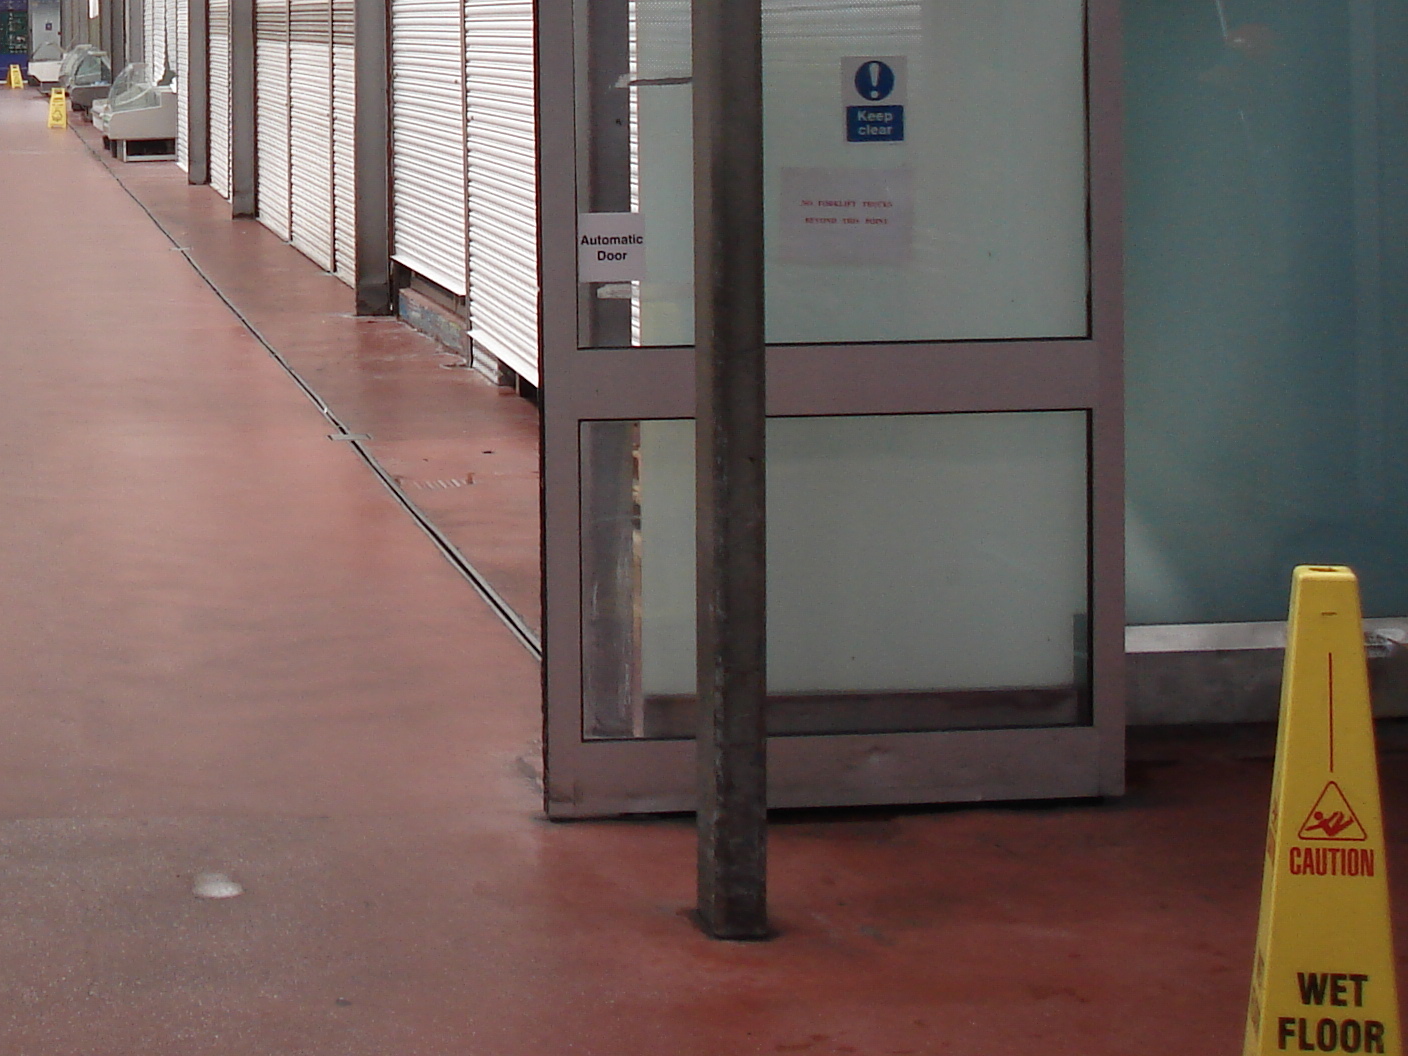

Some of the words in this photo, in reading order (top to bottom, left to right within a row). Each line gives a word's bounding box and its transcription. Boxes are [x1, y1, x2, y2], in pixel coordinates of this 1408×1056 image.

[857, 110, 893, 123] Keep
[858, 123, 892, 135] clear
[580, 234, 644, 245] Automatic
[597, 250, 628, 261] Door
[1289, 846, 1375, 878] CAUTION
[1296, 971, 1369, 1008] WET
[1277, 1016, 1386, 1055] FLOOR
